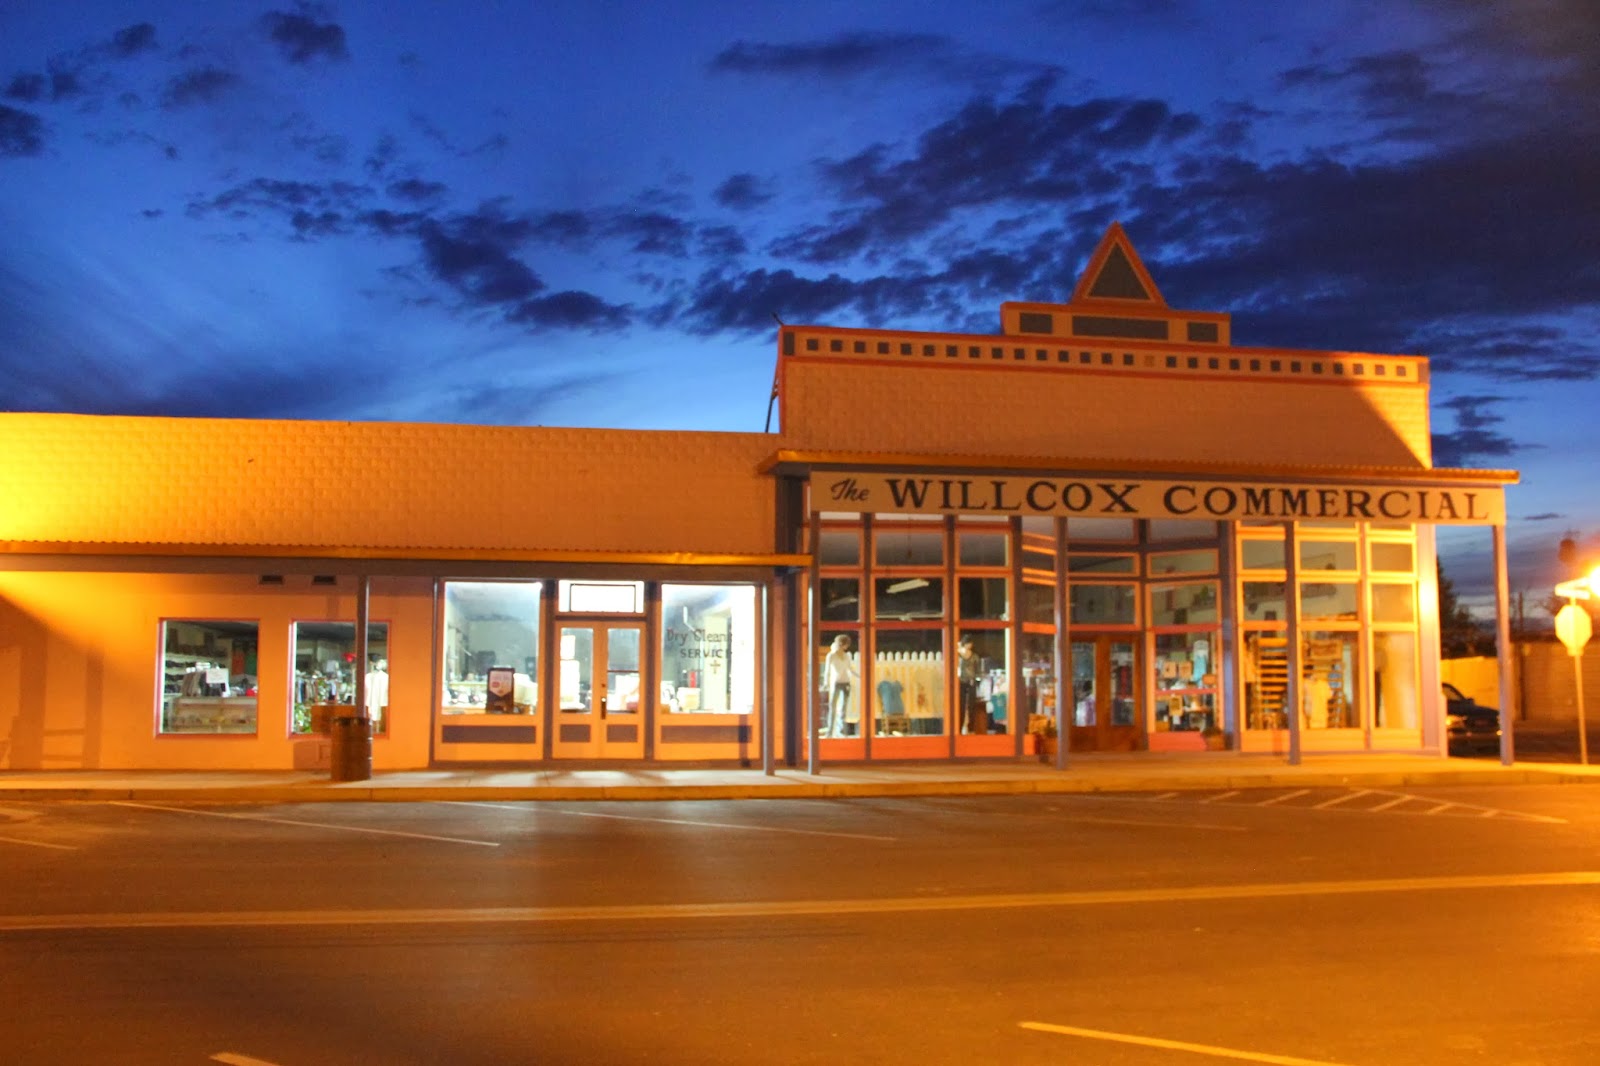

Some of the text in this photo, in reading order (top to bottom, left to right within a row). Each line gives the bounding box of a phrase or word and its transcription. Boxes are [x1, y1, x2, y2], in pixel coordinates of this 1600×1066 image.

[830, 478, 1489, 520] The WILLCOX COMMERCIAL
[666, 628, 688, 646] Dry
